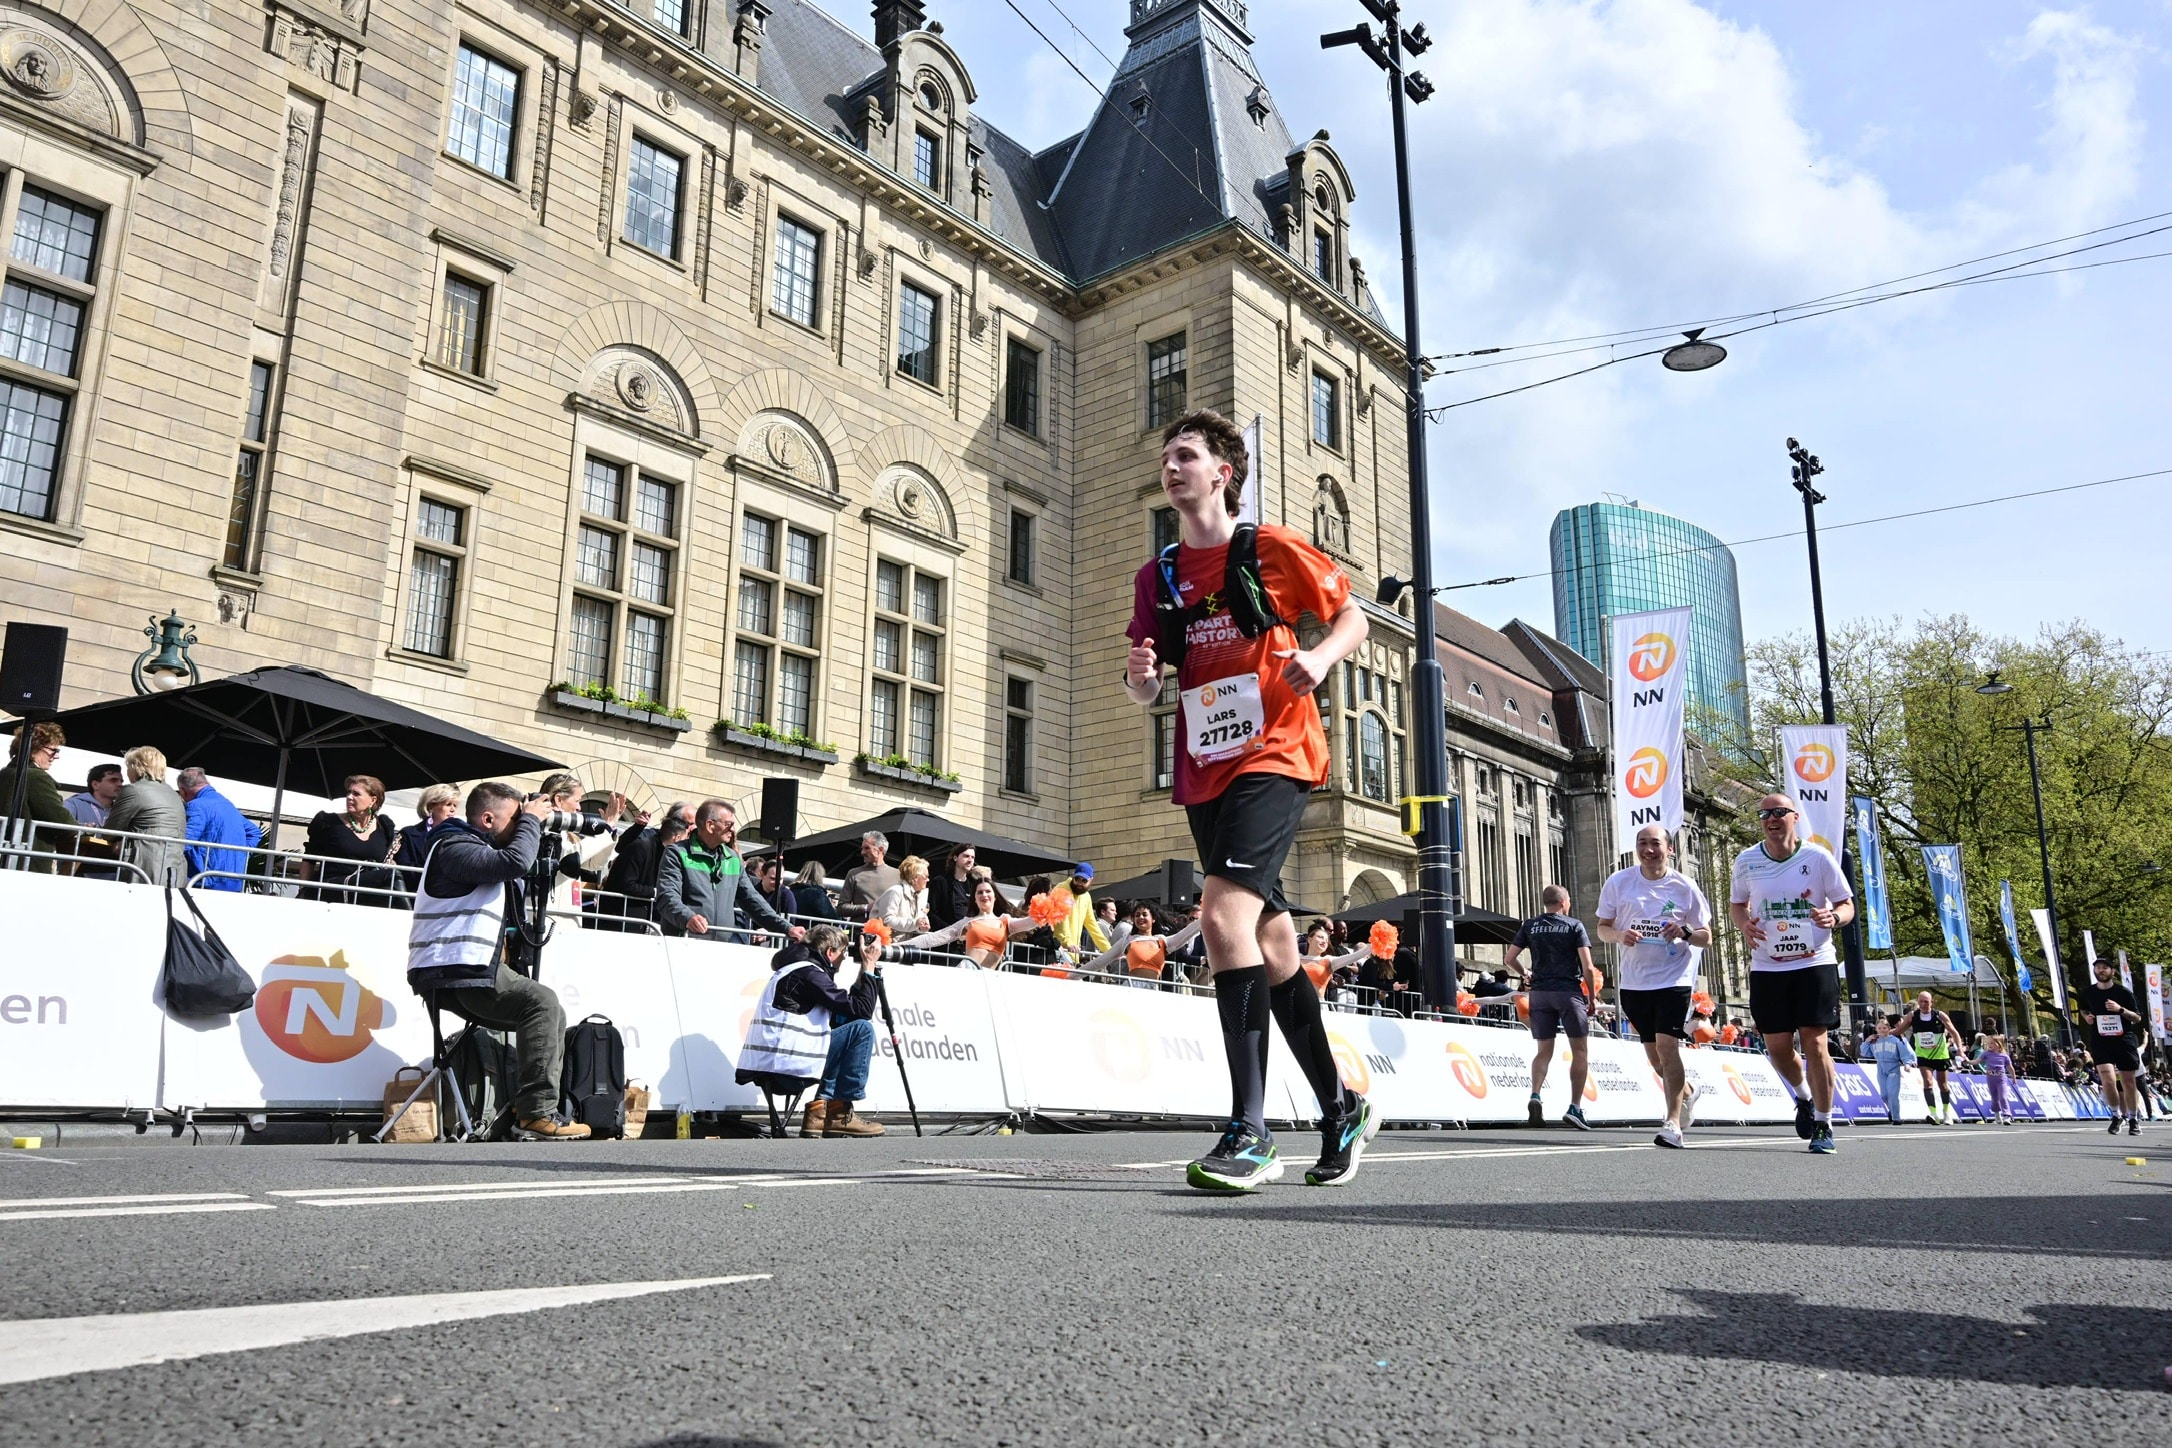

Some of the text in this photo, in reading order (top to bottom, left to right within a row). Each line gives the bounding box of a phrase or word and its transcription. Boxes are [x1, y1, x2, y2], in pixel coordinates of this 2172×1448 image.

[1195, 615, 1232, 631] PART
[1217, 684, 1238, 697] NN
[1633, 688, 1664, 708] NN
[1207, 709, 1237, 725] LARS
[1200, 720, 1254, 747] 27728
[1799, 789, 1828, 802] NN
[1631, 806, 1661, 826] NN
[1630, 924, 1663, 932] RAYMO
[1774, 942, 1807, 952] 17079
[1160, 1036, 1204, 1062] NN
[1365, 1054, 1397, 1074] NN
[1479, 1052, 1527, 1069] nationale
